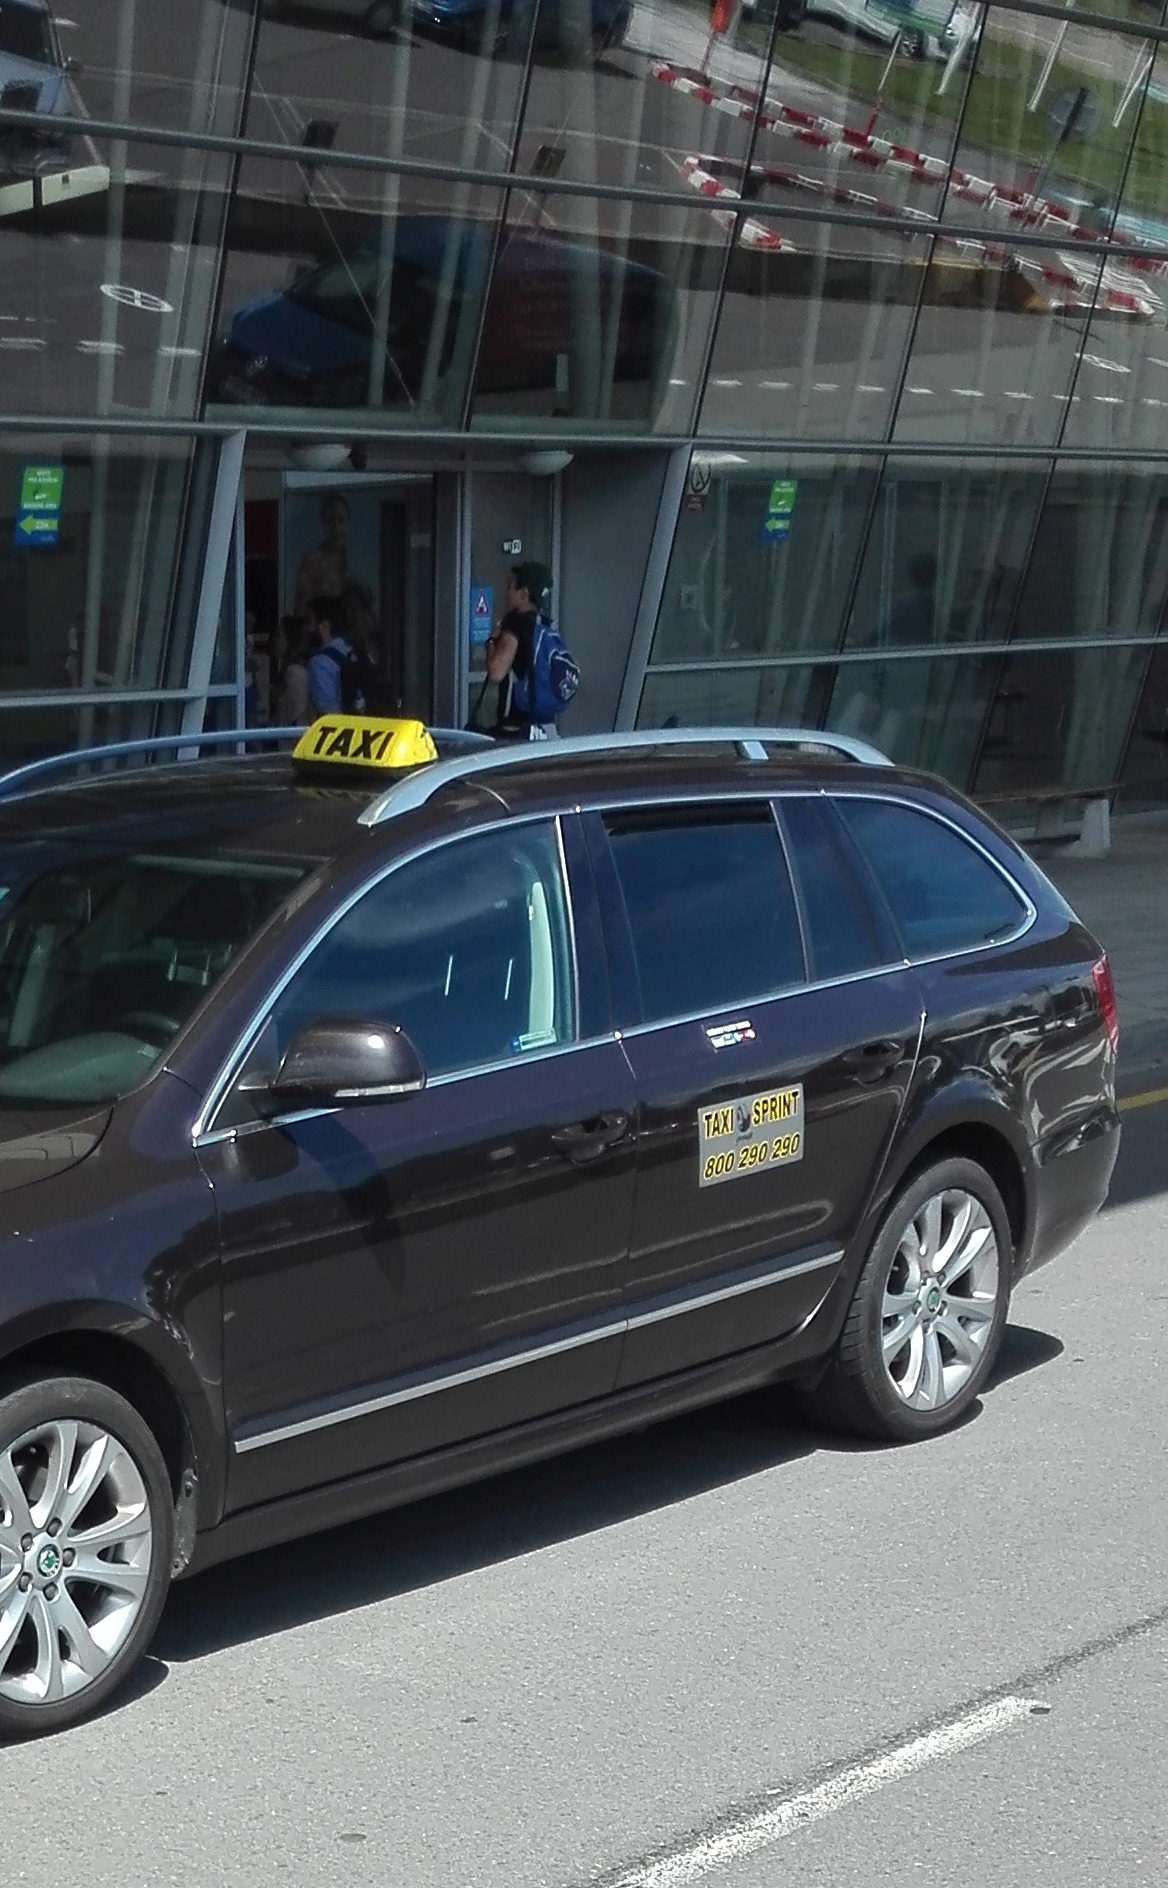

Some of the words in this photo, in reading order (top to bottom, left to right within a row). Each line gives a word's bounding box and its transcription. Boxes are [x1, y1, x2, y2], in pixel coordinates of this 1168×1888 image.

[313, 726, 394, 760] TAXI
[703, 1106, 734, 1140] TAXI
[752, 1089, 800, 1127] SPRINT
[704, 1150, 735, 1180] 800
[737, 1141, 769, 1170] 290
[770, 1132, 801, 1161] 290
